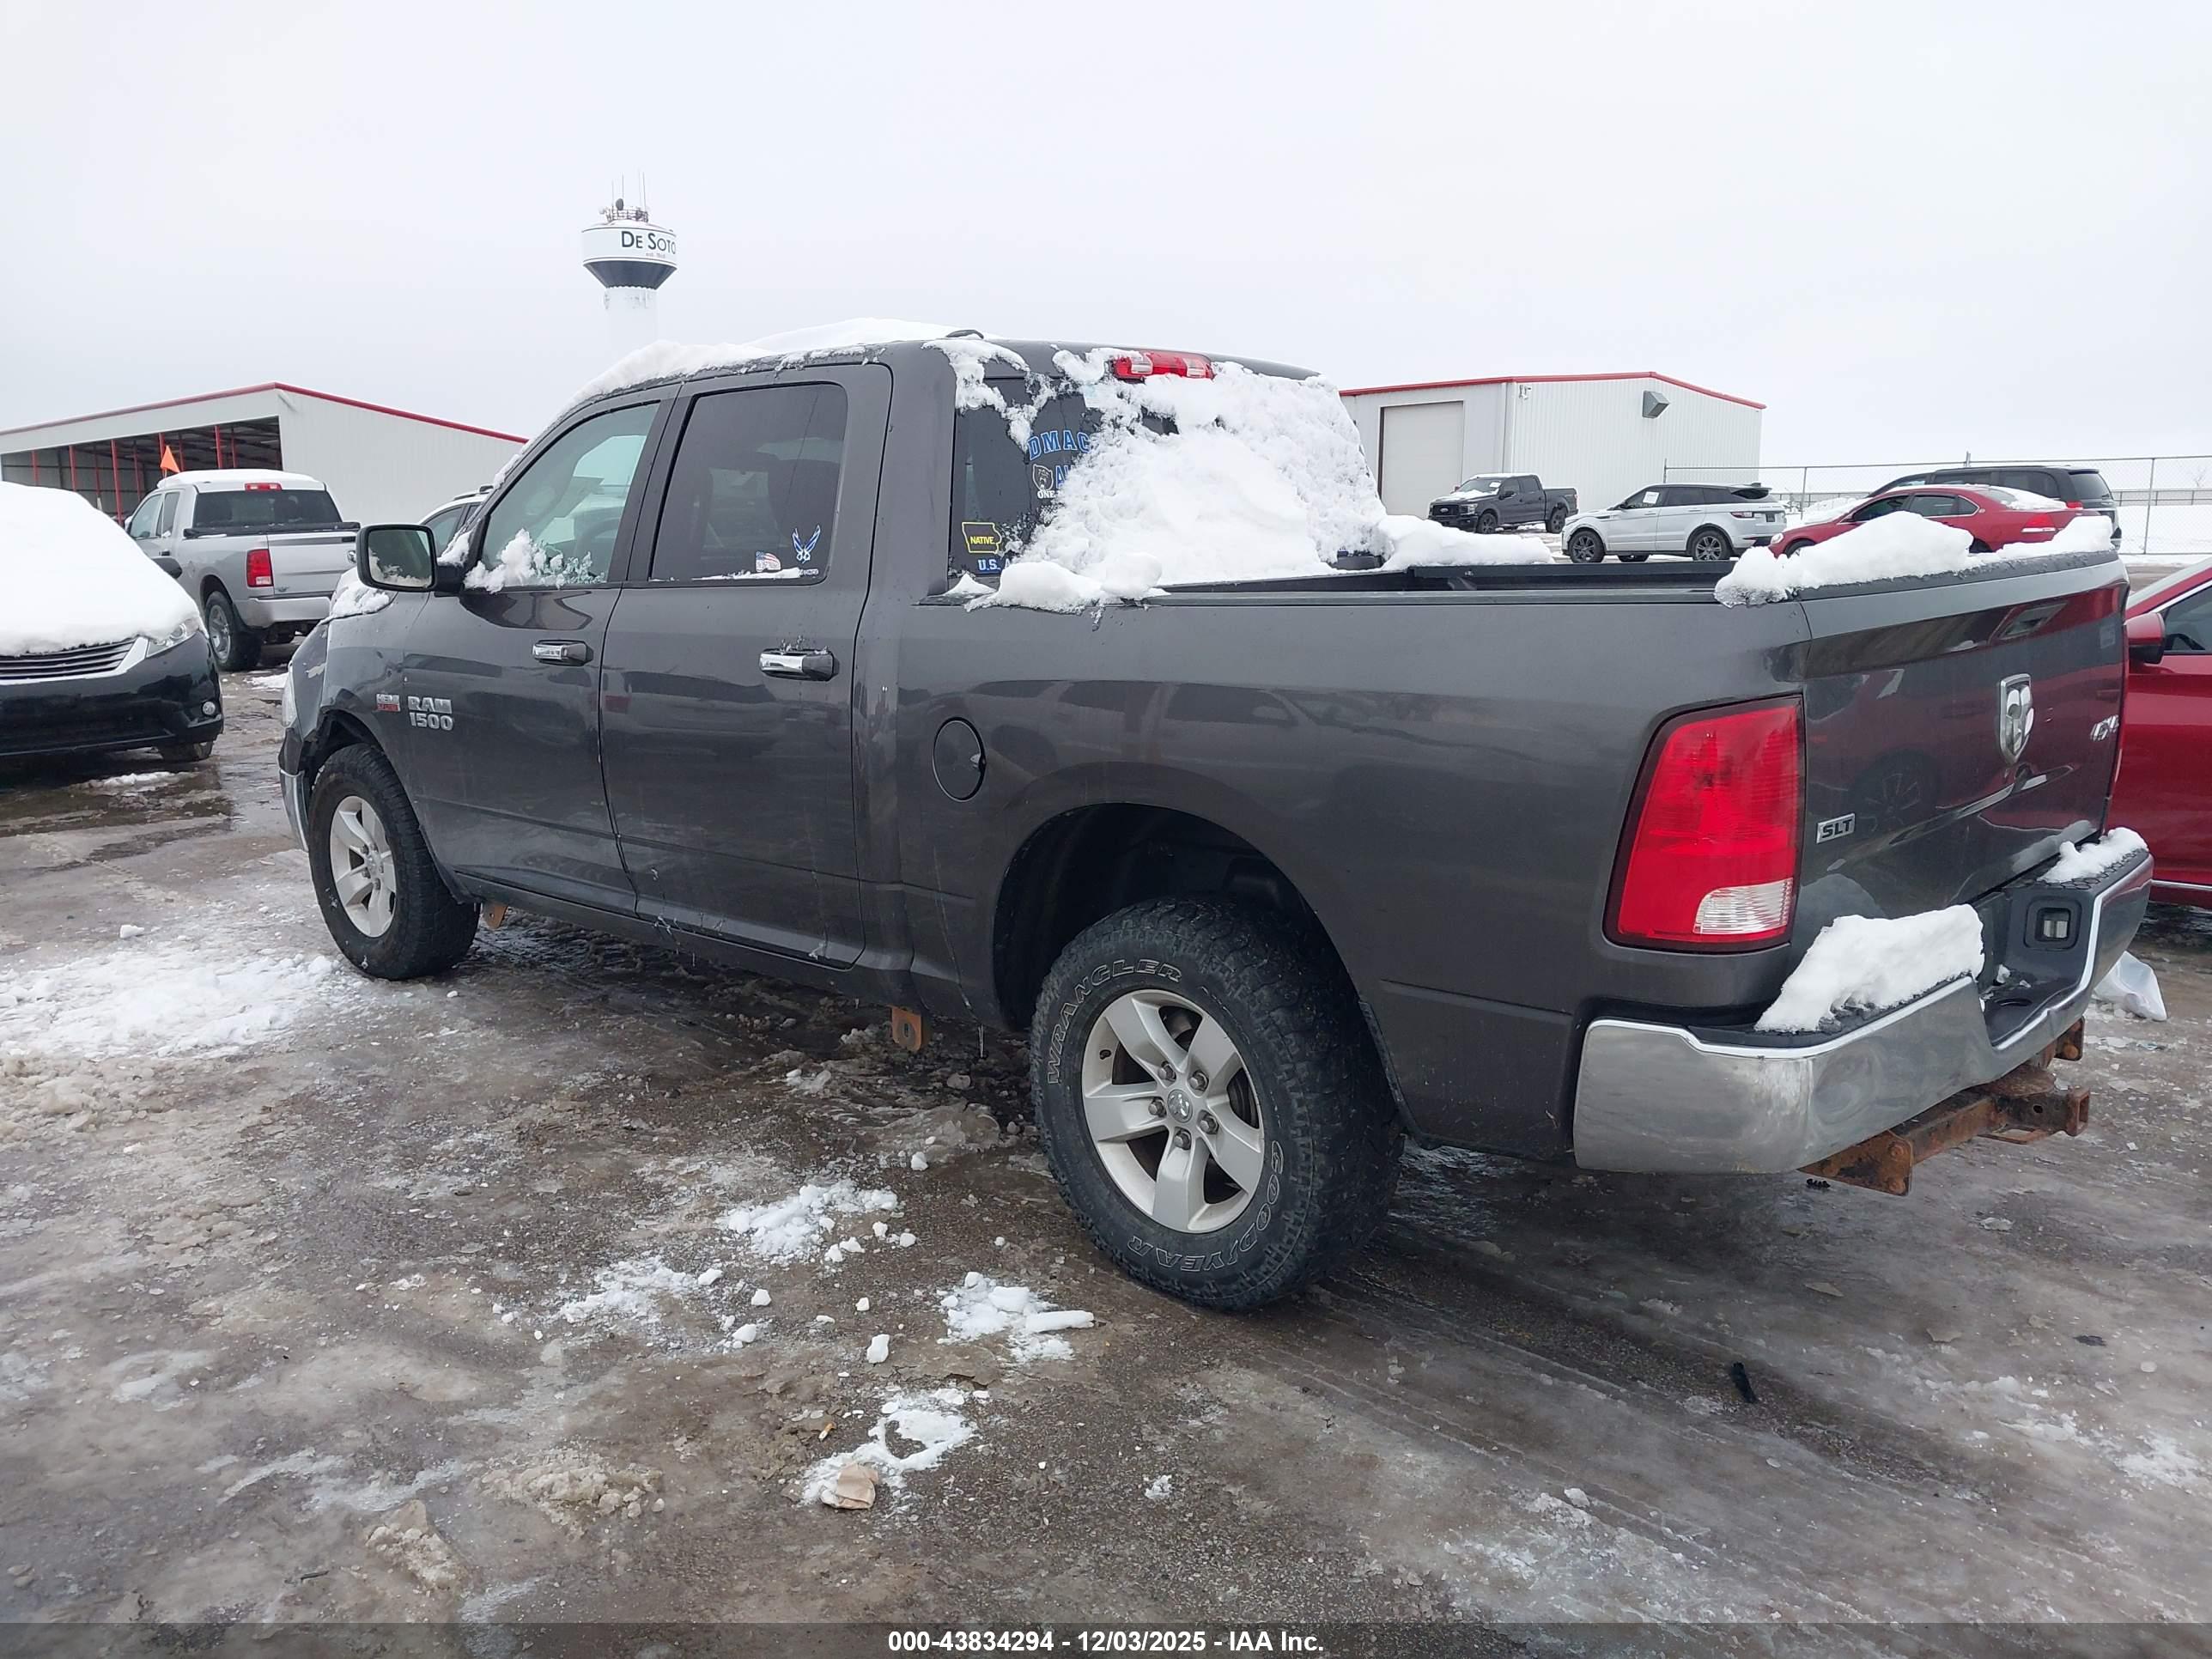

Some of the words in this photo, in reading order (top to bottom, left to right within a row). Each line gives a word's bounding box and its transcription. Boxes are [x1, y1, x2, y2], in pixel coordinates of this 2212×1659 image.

[969, 536, 995, 544] NATIVE
[977, 559, 1001, 571] U.S.
[408, 696, 452, 714] RAM
[409, 712, 453, 731] 1500
[1821, 818, 1853, 839] SLT
[1047, 958, 1182, 1085] WRANGLER
[1127, 1139, 1285, 1273] GOODYEAR
